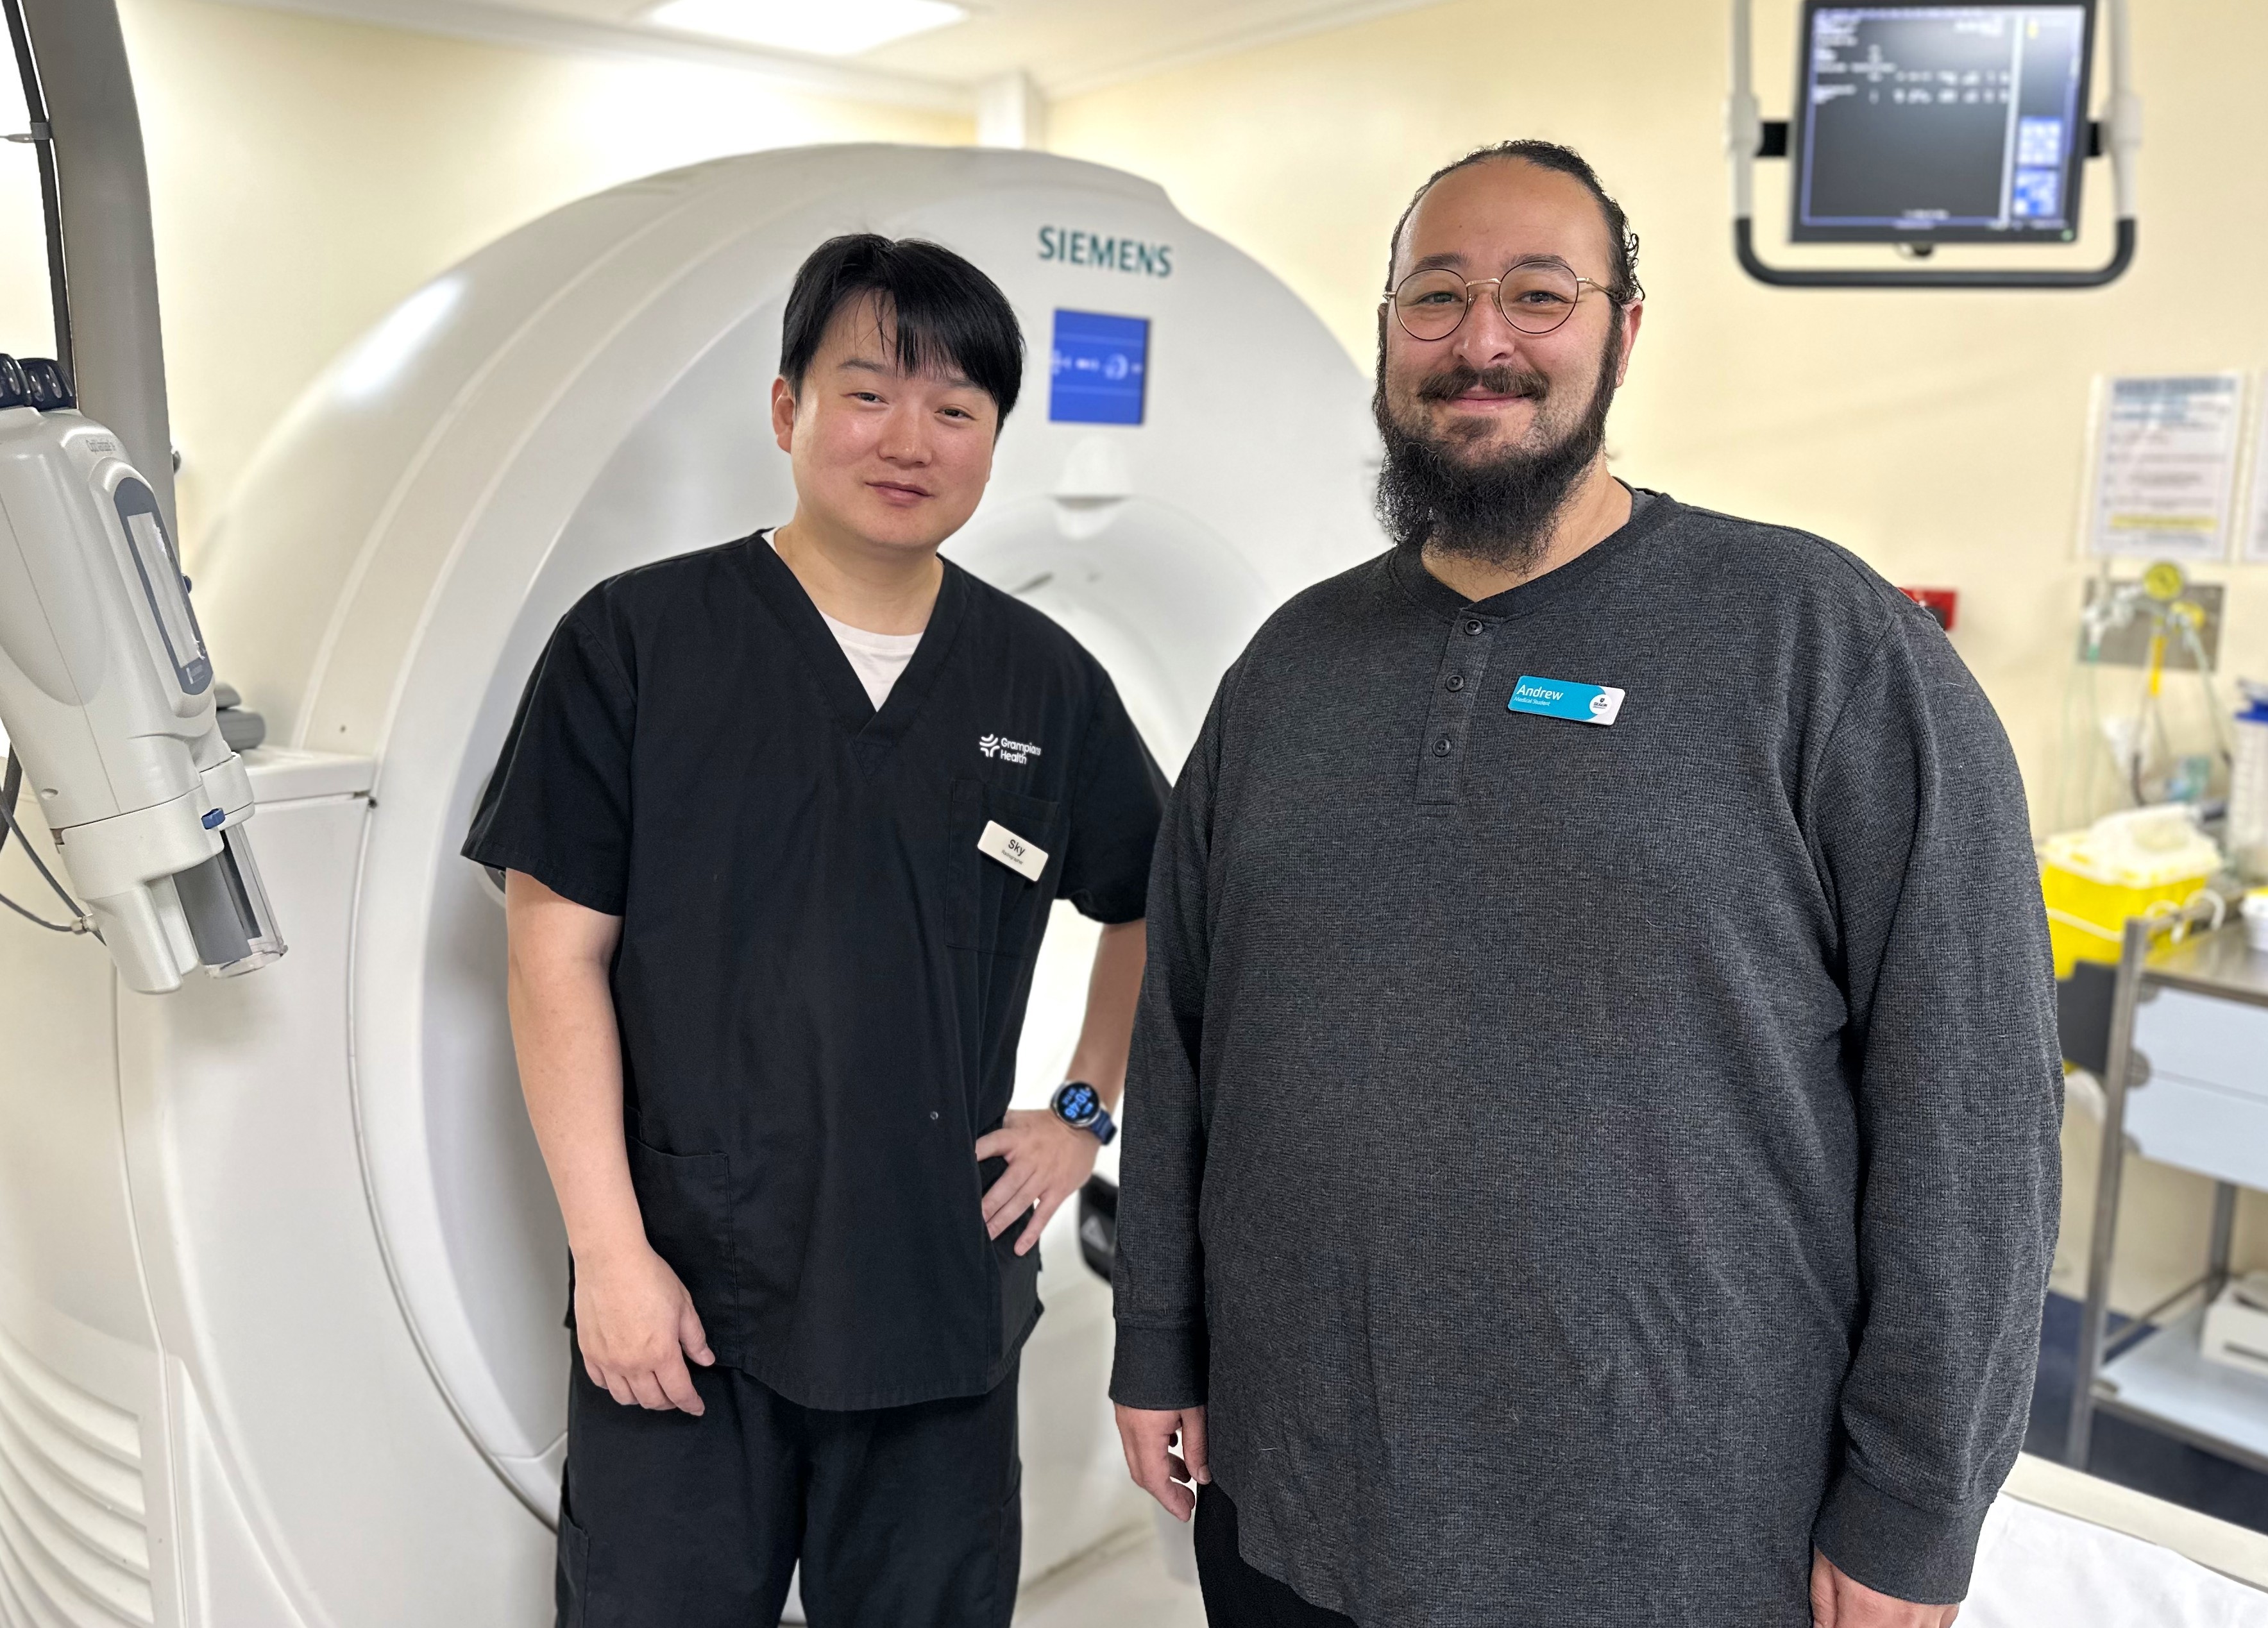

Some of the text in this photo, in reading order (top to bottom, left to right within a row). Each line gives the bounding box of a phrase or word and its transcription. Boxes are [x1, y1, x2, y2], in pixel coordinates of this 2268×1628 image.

[1038, 225, 1172, 278] SIEMENS
[1513, 696, 1532, 704] Medical
[1516, 684, 1564, 700] Andrew
[1001, 737, 1042, 756] Grampians
[1000, 749, 1027, 765] Health
[1008, 839, 1026, 857] Sky
[1001, 849, 1024, 865] Radiographer
[1065, 1089, 1092, 1118] 10:46
